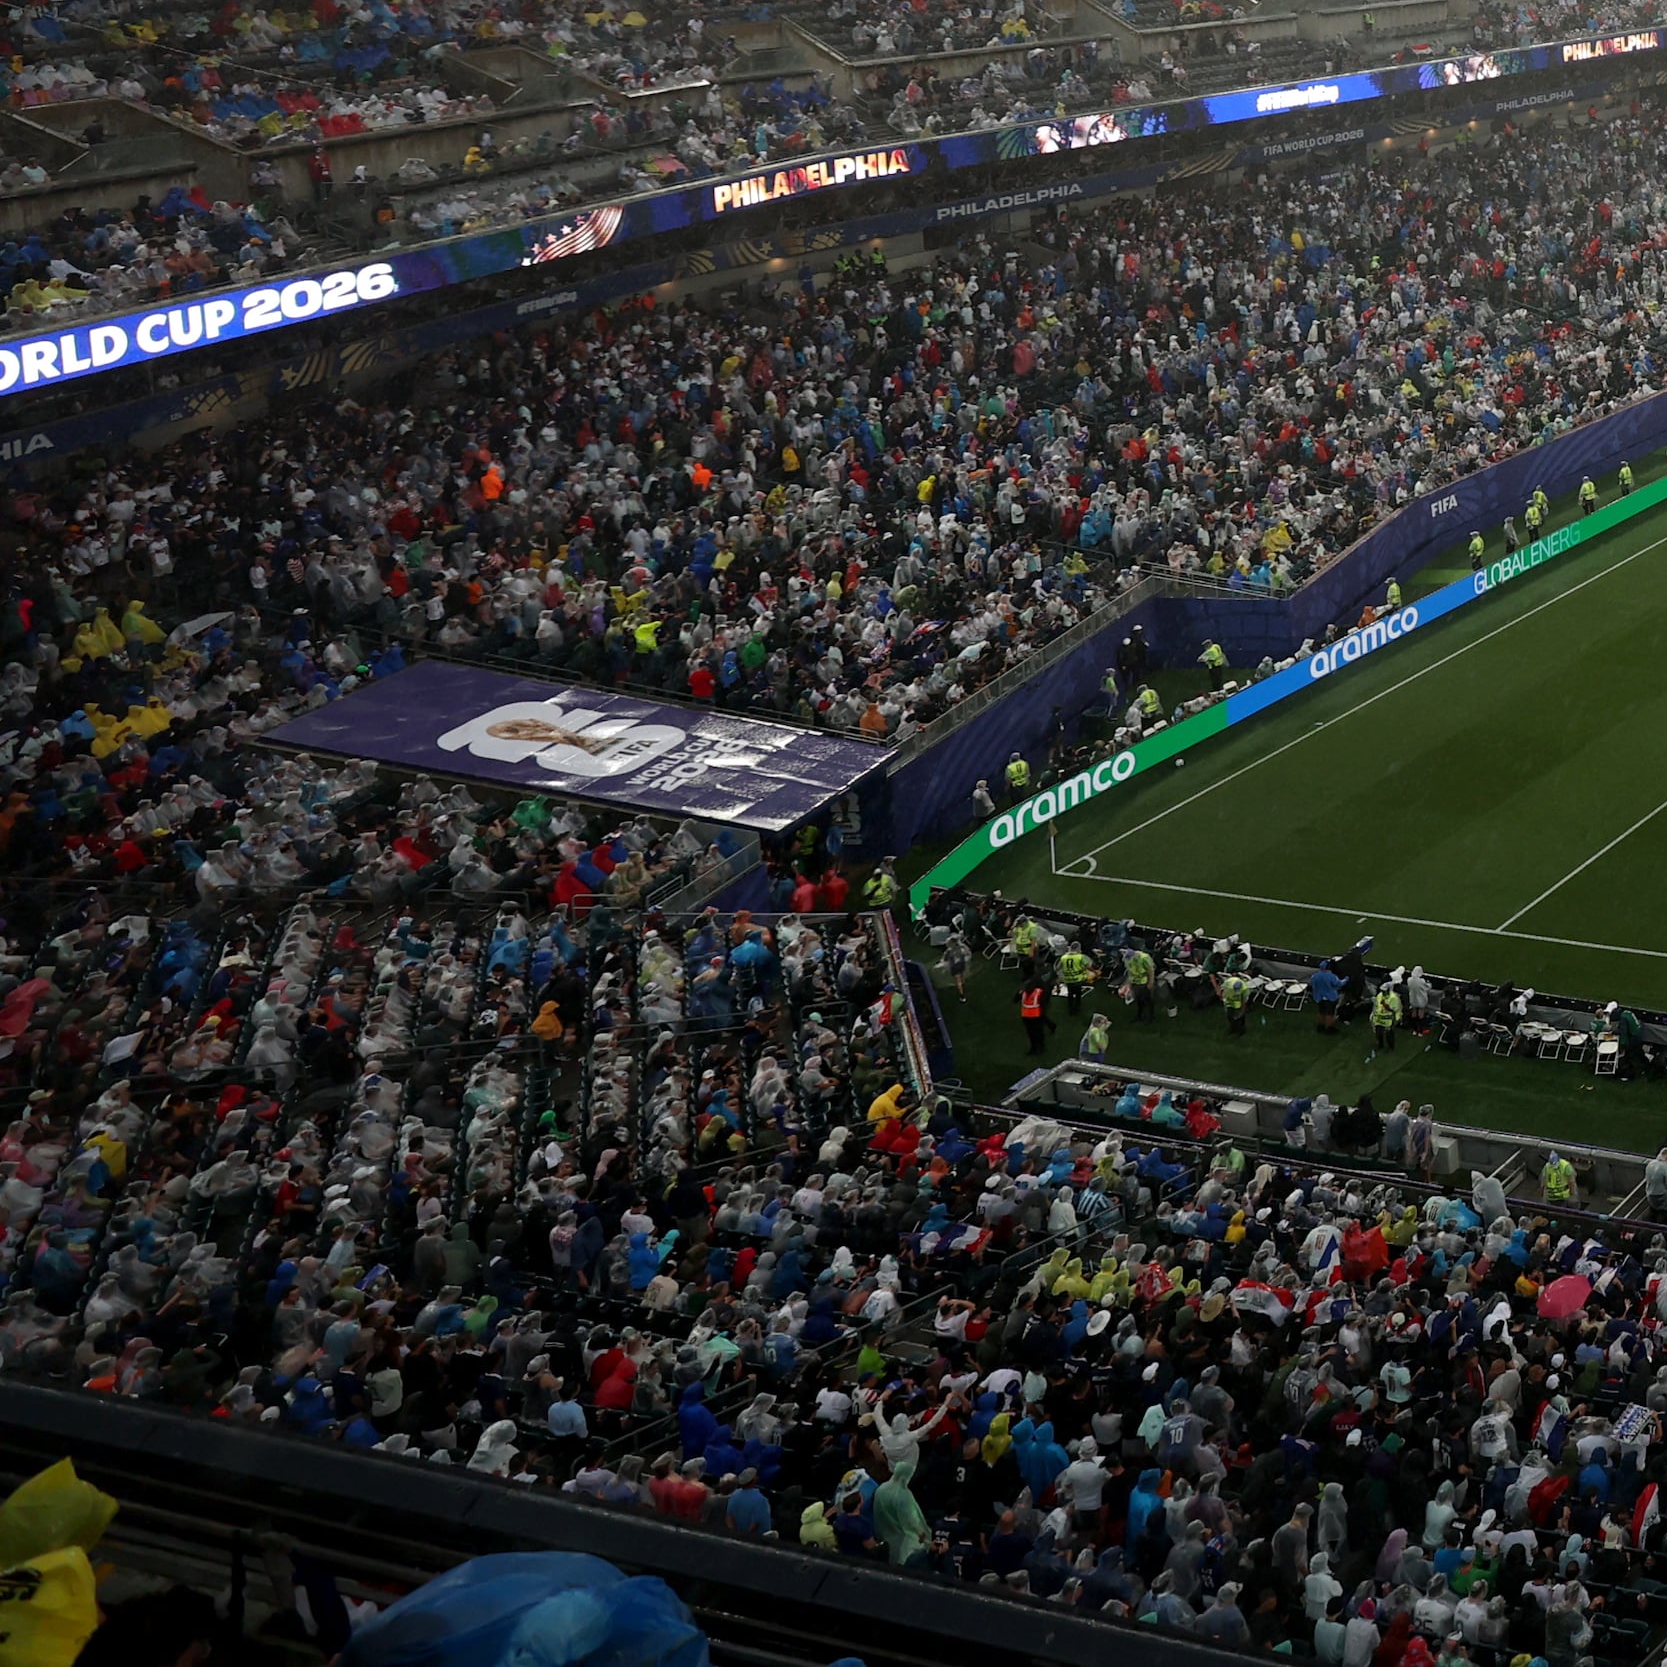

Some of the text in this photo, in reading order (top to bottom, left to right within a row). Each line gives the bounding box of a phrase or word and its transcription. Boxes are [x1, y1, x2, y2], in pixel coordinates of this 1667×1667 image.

[1562, 31, 1658, 62] PHILADELPHIA
[1496, 89, 1575, 112] PHILADELPHIA
[1264, 129, 1365, 156] FIFA WORLD CUP 2026
[714, 149, 910, 213] PHILADELPHIA
[936, 182, 1083, 221] PHILADELPHIA
[136, 299, 234, 353] CUP
[242, 263, 394, 330] 2026
[1431, 494, 1458, 518] FIFA
[1474, 550, 1530, 595] GLOBAL
[1310, 606, 1418, 678] aramco
[608, 740, 661, 762] FIFA
[650, 739, 750, 792] 2026
[625, 752, 690, 784] WORLD
[990, 750, 1136, 848] aramco
[1314, 1231, 1325, 1251] 10
[1169, 1426, 1183, 1445] 10
[956, 1466, 966, 1482] 3
